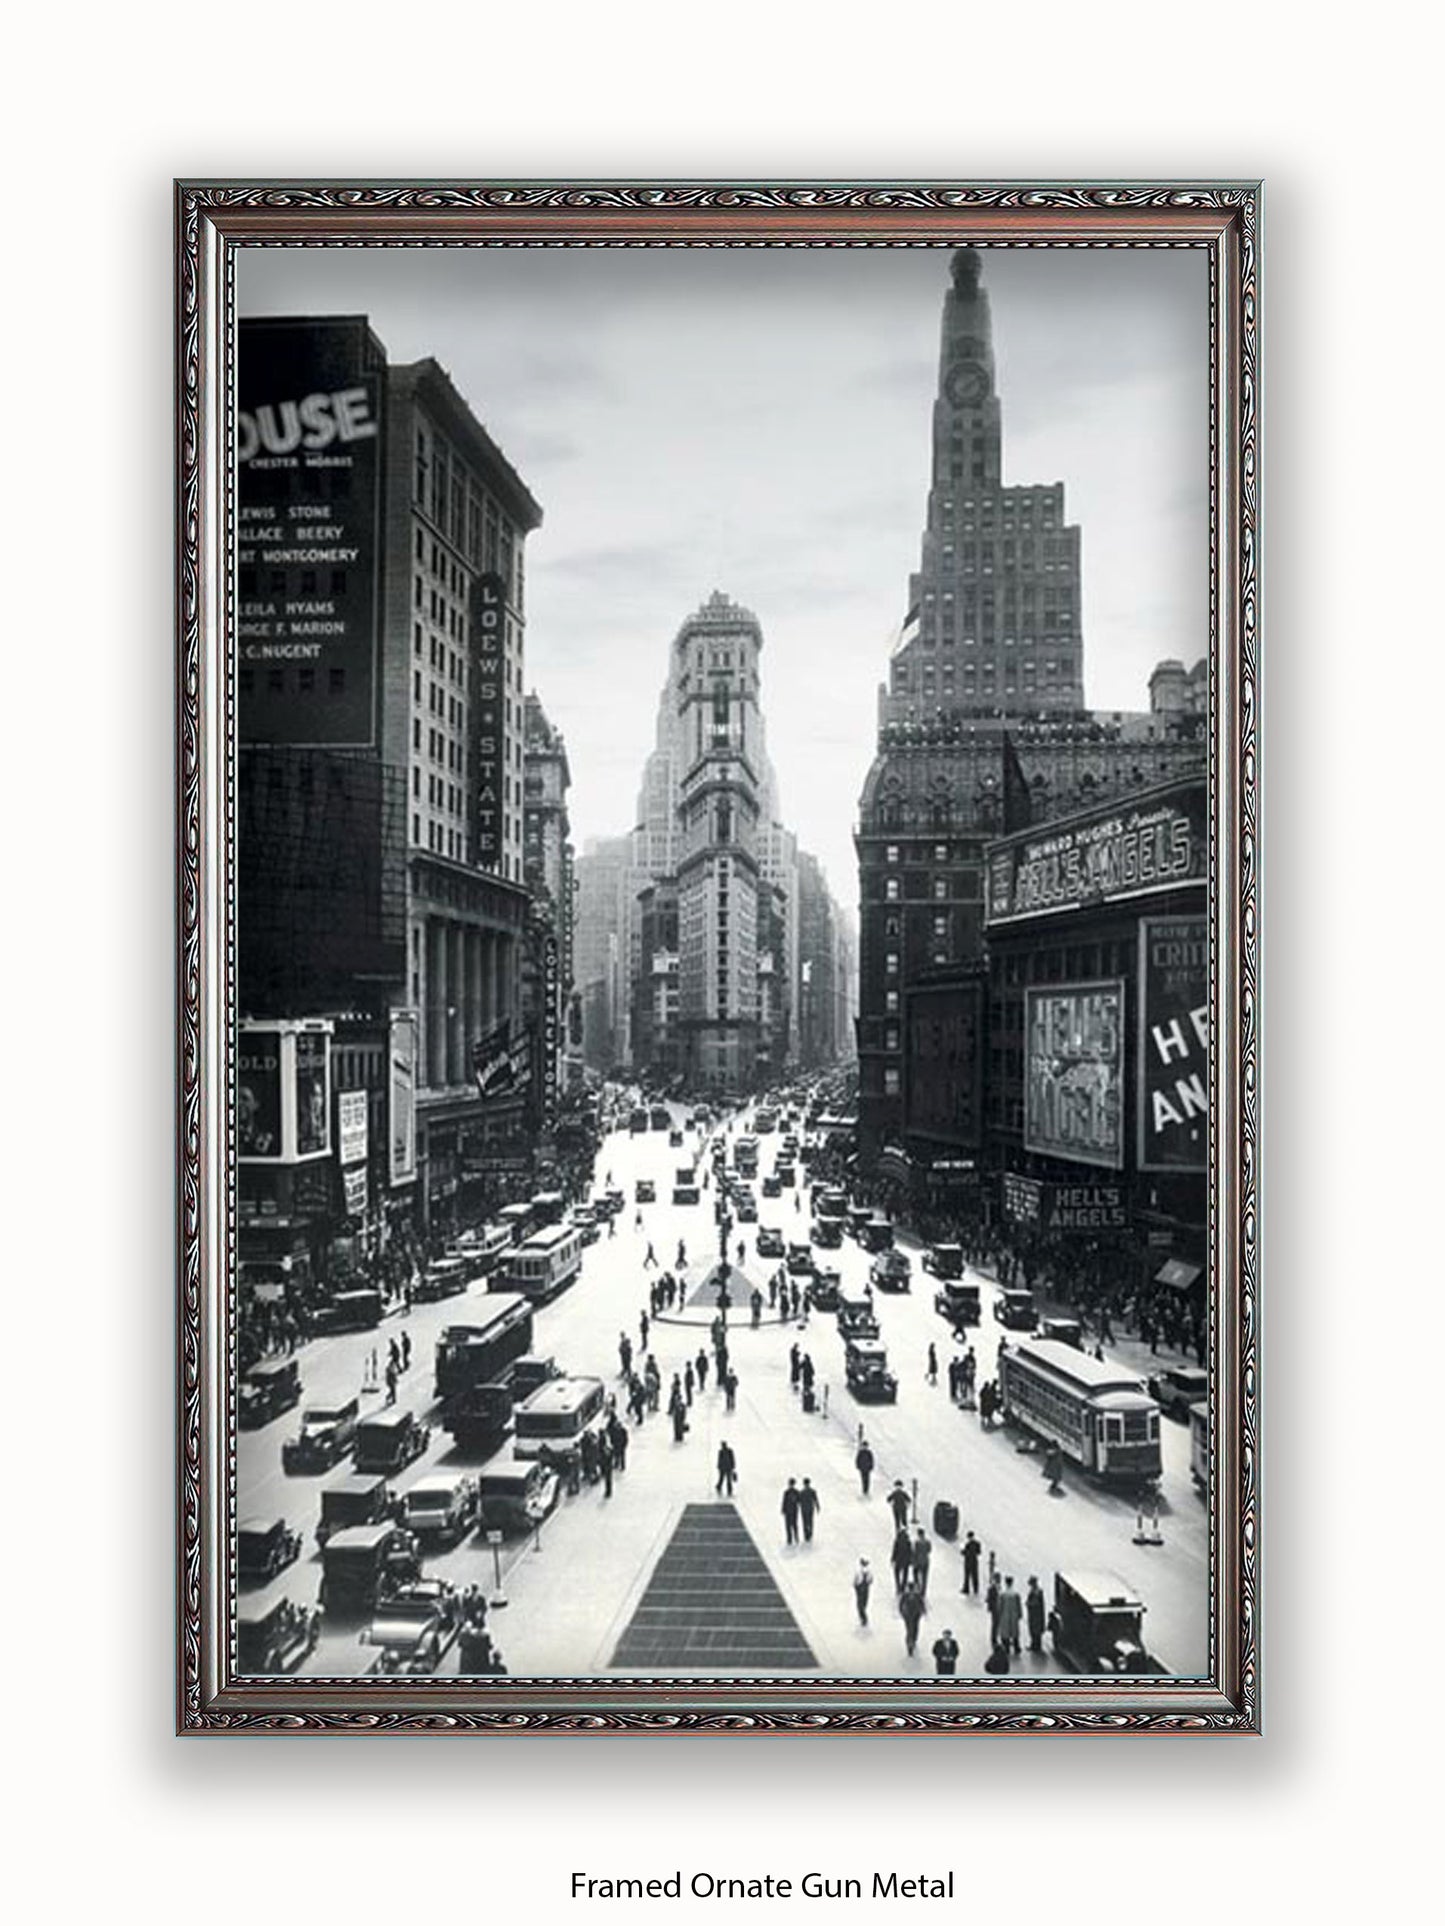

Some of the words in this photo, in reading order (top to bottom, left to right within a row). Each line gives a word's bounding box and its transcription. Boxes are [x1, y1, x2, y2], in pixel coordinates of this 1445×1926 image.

[288, 505, 331, 518] STONE
[296, 525, 344, 540] BEERY
[262, 548, 359, 562] MONTGOMERY
[286, 601, 335, 615] HYAMS
[290, 621, 345, 634] MARION
[1086, 817, 1190, 890] ANGELS
[1050, 1207, 1126, 1226] ANGELS
